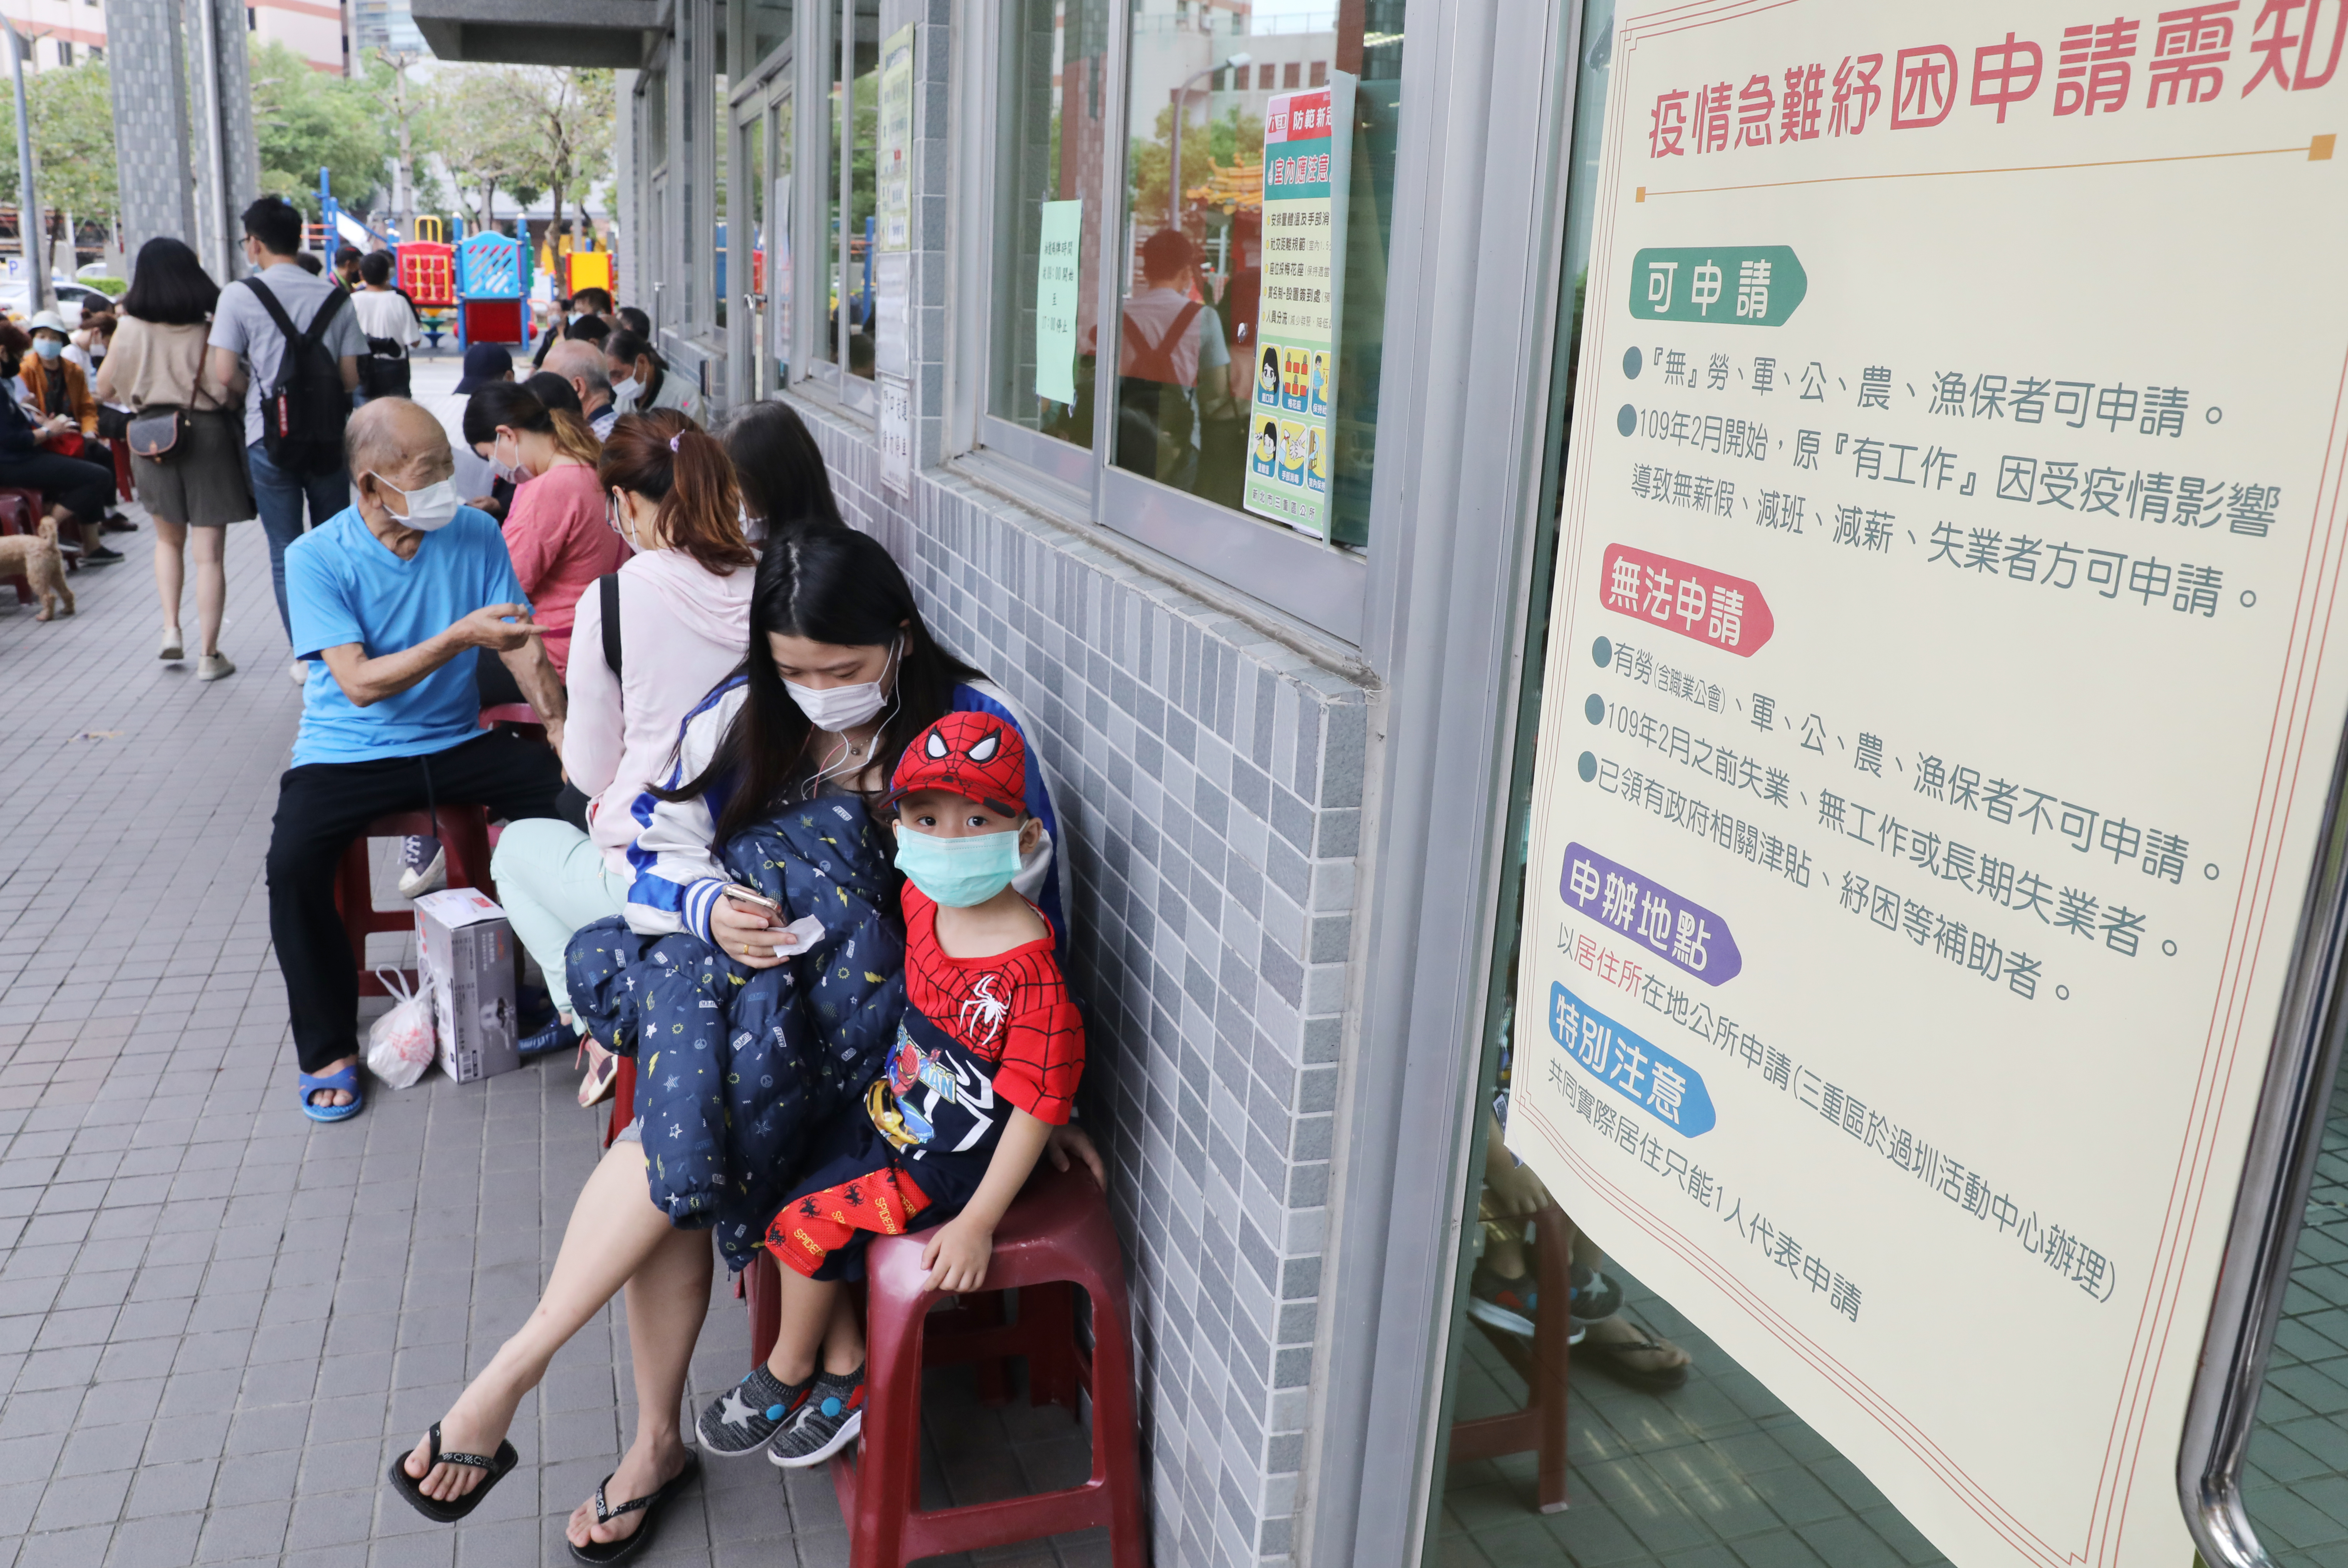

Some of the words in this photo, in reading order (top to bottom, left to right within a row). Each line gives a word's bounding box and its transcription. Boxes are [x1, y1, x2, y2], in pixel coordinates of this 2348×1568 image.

[1649, 0, 2348, 158] 疫情急難紓困申請需知
[1274, 153, 1331, 185] 室內應注意
[1647, 259, 1772, 319] 可申請
[1654, 347, 2222, 438] 『無』勞、軍、公、農、漁保者可申請。
[1631, 463, 2256, 618] 導致無薪假、減班、減薪、失業者方可申請。
[1610, 556, 1744, 646] 無法申請
[1598, 759, 2070, 1001] 已領有政府相關津貼、紓困等補助者。
[1608, 702, 2177, 957] 109年2月之前失業、無工作或長期失業者。
[616, 950, 626, 967] SUPER
[1569, 858, 1711, 971] 申辦地點
[735, 1032, 751, 1047] SUPER
[774, 1027, 785, 1046] PEACE
[1556, 993, 1686, 1125] 特別注意
[1557, 922, 2115, 1303] 以居住所在地公所申請(三重區於過圳活動中心辦理)
[1548, 1057, 1862, 1323] 共同實際居住只能1人代表申請
